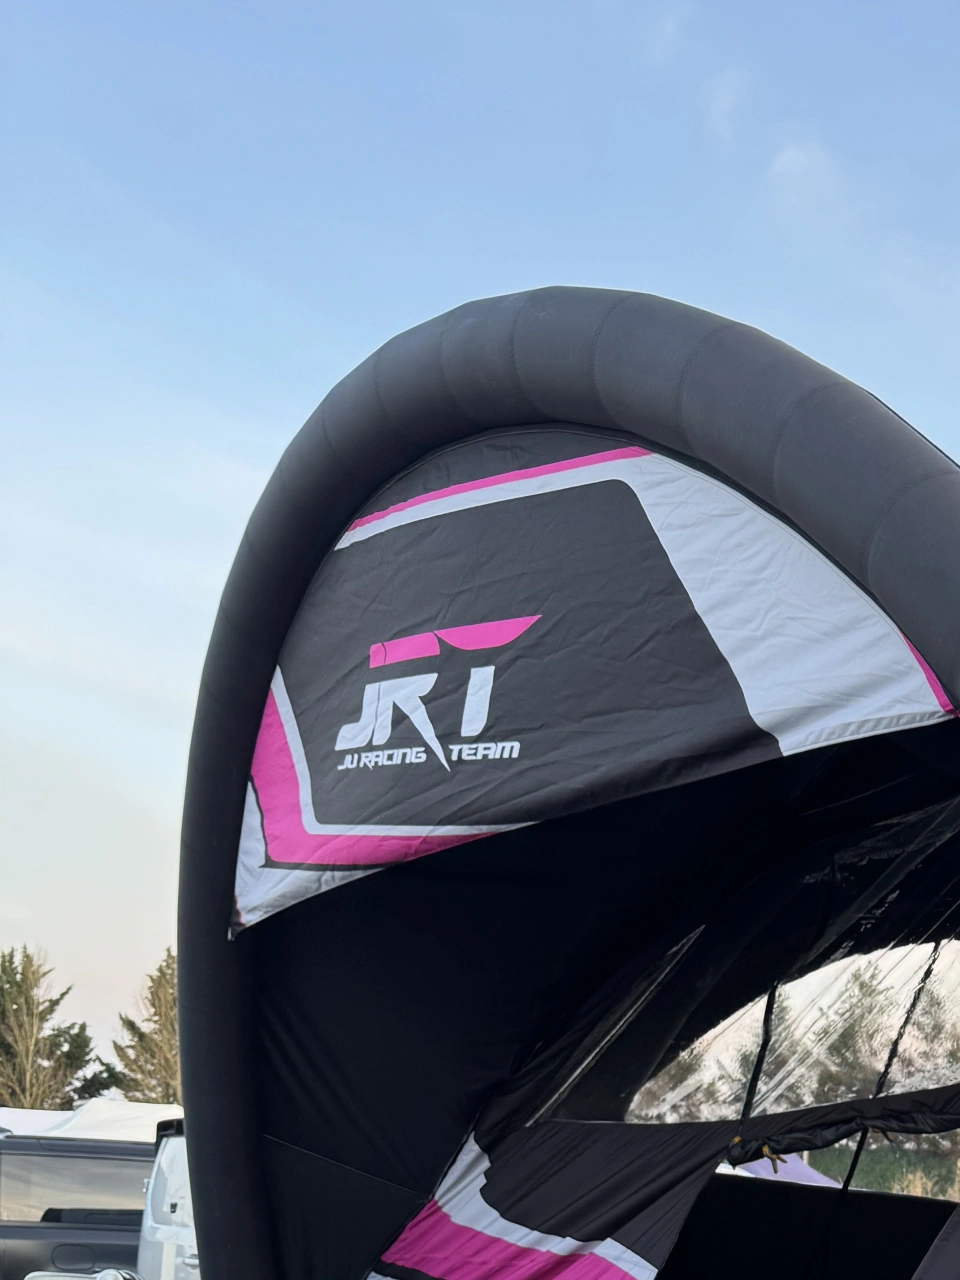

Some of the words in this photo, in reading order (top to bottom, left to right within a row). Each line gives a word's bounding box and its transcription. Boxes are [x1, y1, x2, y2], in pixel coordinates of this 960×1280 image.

[334, 614, 543, 772] JRT
[337, 753, 358, 770] JU
[360, 747, 427, 770] RACING
[449, 741, 520, 761] TEAM
